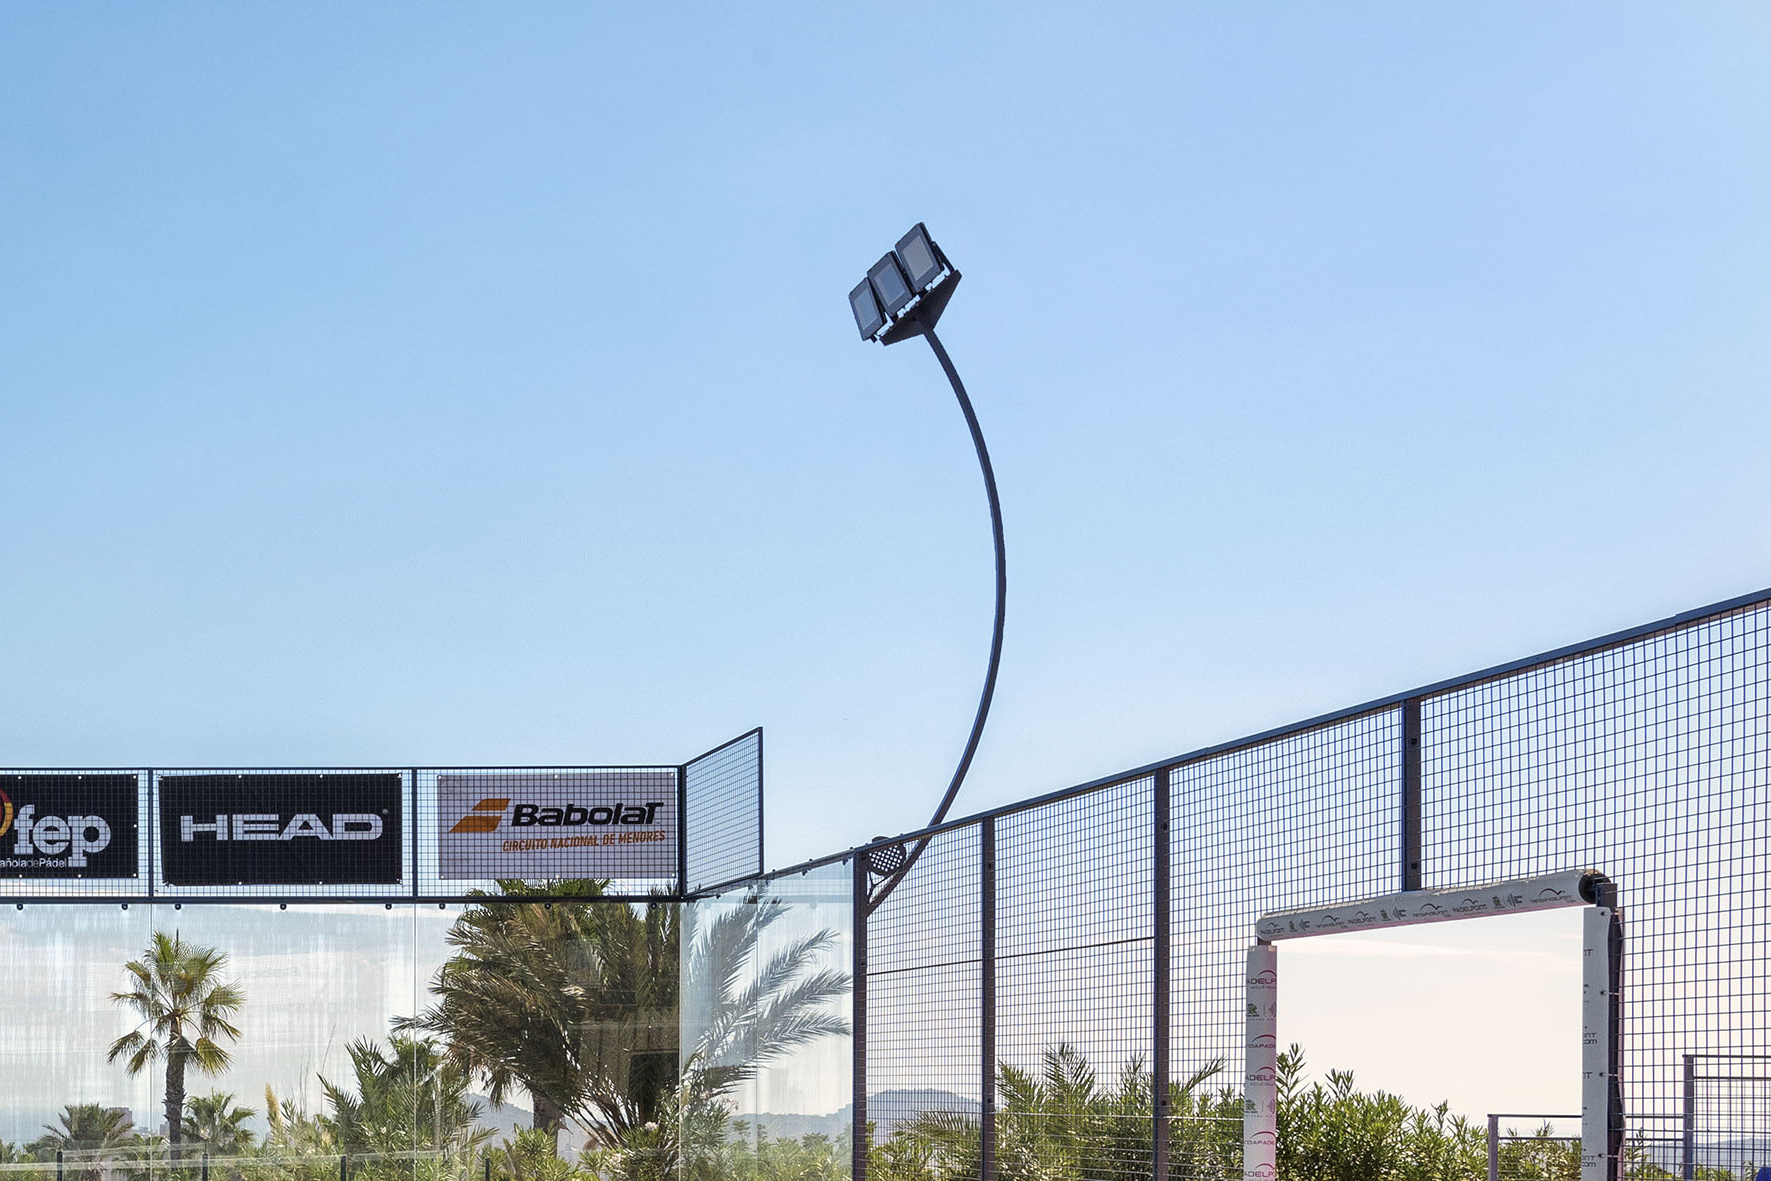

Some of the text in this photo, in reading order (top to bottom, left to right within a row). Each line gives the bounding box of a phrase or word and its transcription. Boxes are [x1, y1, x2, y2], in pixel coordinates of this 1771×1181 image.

[14, 804, 111, 868] fep
[180, 814, 383, 842] HEAD
[502, 830, 666, 852] CIRCUITO NACIONAL DE MENORES
